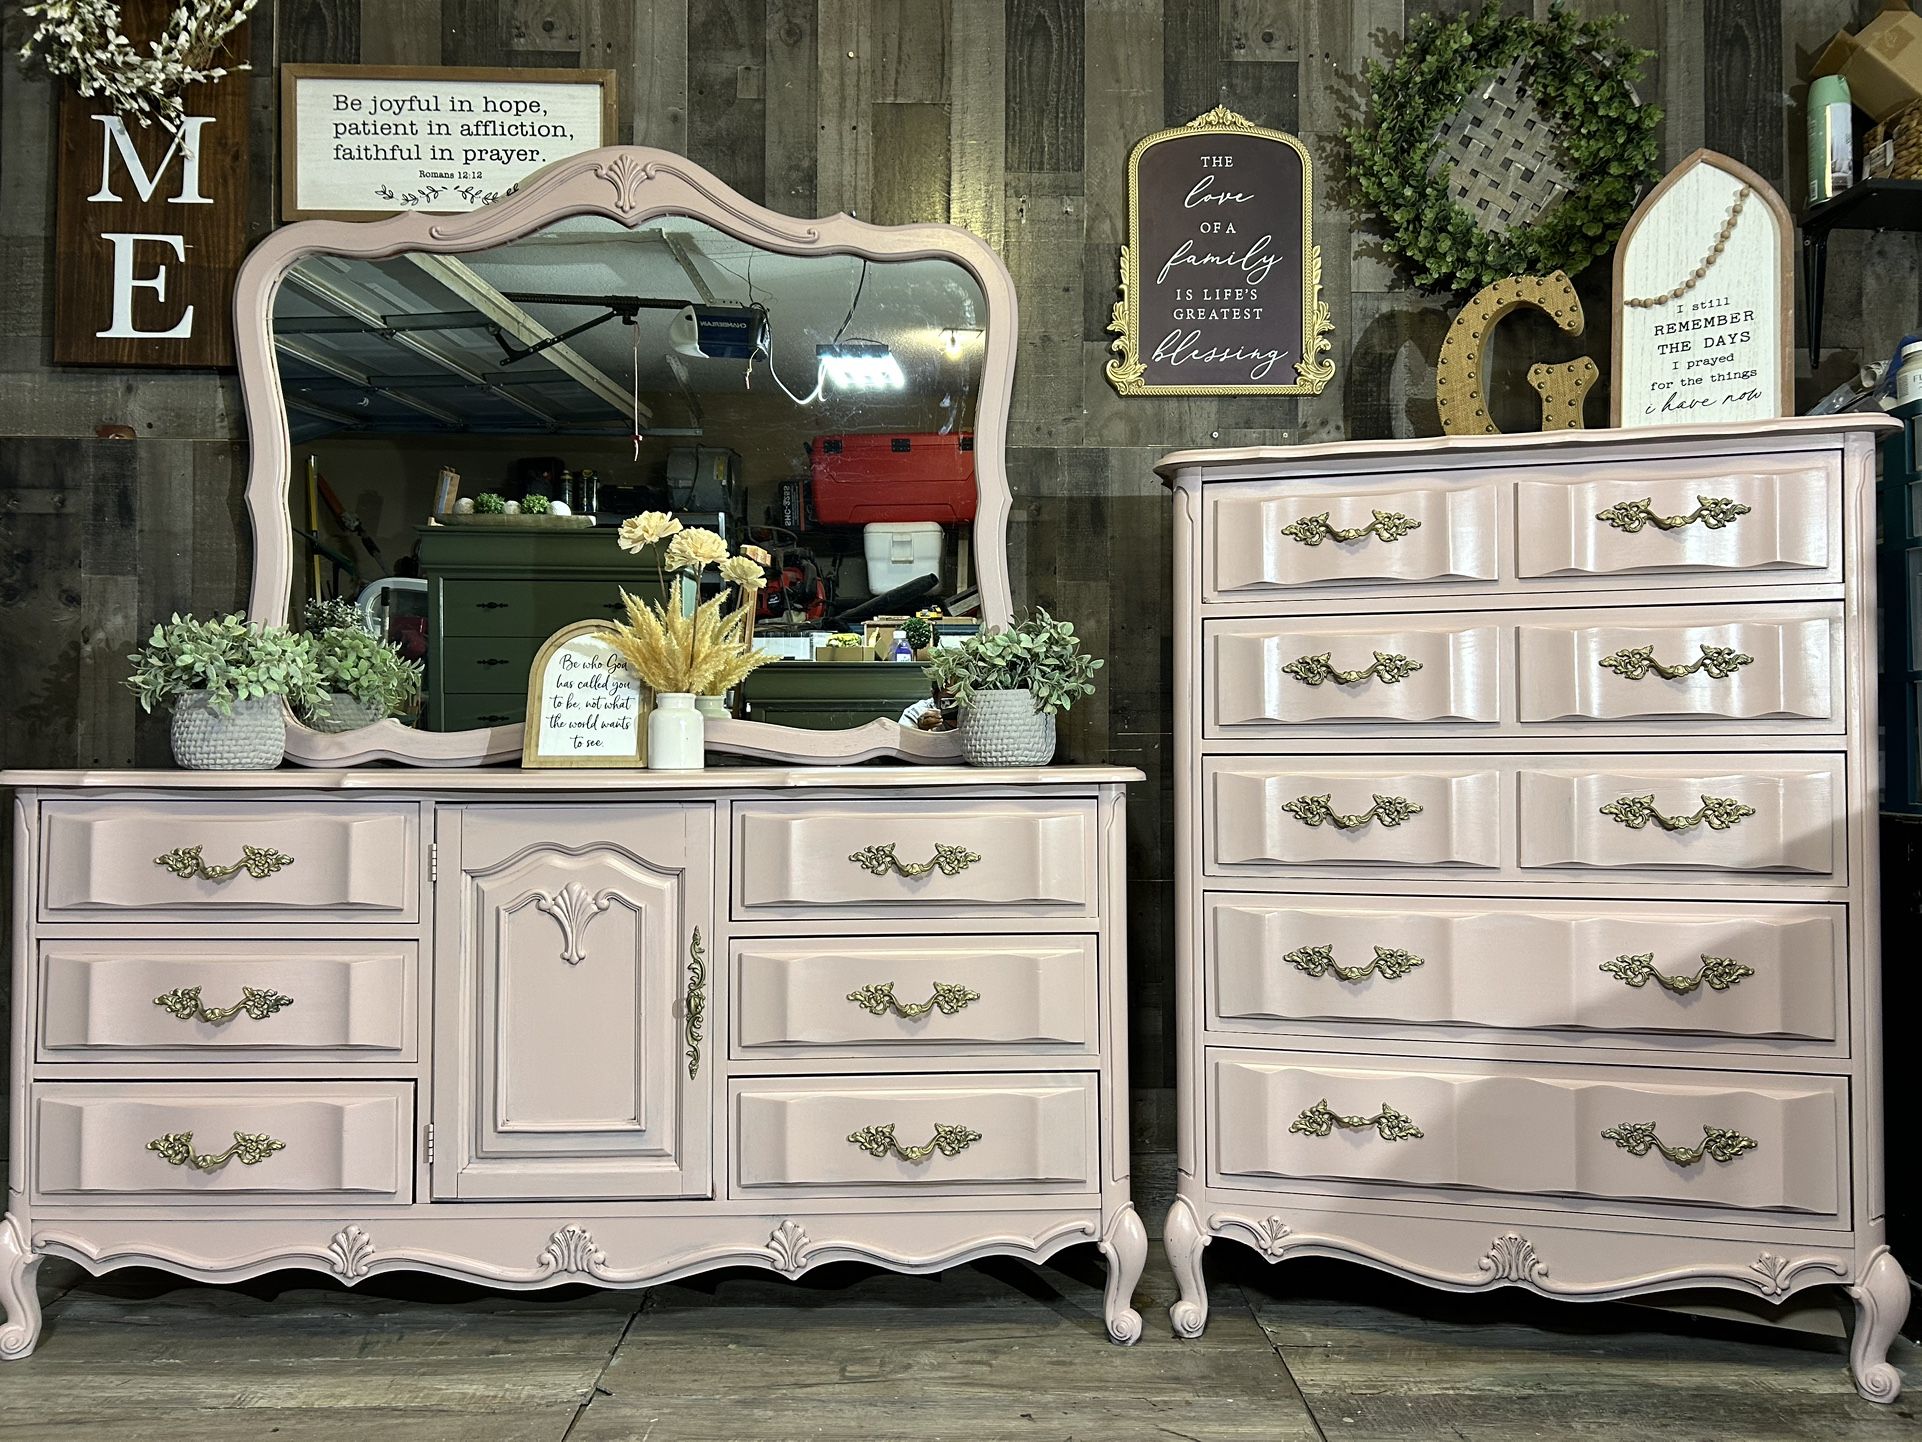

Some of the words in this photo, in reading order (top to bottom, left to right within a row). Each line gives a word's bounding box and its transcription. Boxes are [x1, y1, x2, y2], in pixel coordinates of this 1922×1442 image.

[332, 94, 362, 112] Be
[368, 95, 441, 116] joyful
[449, 96, 474, 113] in
[482, 96, 548, 117] hope,
[332, 119, 419, 139] patient
[427, 120, 451, 136] in
[459, 120, 574, 141] affliction,
[333, 143, 422, 161] faithful
[430, 145, 452, 161] in
[462, 148, 547, 165] prayer.
[1200, 155, 1234, 168] THE
[418, 169, 455, 179] Romans
[457, 171, 483, 180] 12:12
[1184, 174, 1255, 209] love
[1199, 221, 1221, 234] OF
[1225, 222, 1237, 234] A
[1156, 234, 1284, 286] family
[1176, 288, 1193, 301] IS
[1203, 288, 1258, 301] LIFE'S
[1173, 308, 1263, 321] GREATEST
[1677, 304, 1684, 314] I
[1692, 297, 1730, 311] still
[1654, 309, 1755, 337] REMEMBER
[1657, 340, 1692, 356] THE
[1704, 331, 1751, 349] DAYS
[1151, 328, 1289, 380] blessing
[1672, 361, 1679, 371] I
[1686, 353, 1735, 371] prayed
[1650, 381, 1674, 391] for
[1680, 377, 1703, 387] the
[1710, 369, 1758, 382] things
[1645, 403, 1656, 415] i
[1661, 391, 1717, 413] have
[1722, 388, 1762, 405] now
[559, 653, 580, 671] Be
[582, 654, 603, 670] who
[556, 674, 574, 689] has
[577, 673, 611, 691] called
[611, 681, 631, 696] you
[549, 695, 563, 709] to
[566, 693, 581, 710] be,
[585, 696, 607, 710] not
[604, 694, 635, 711] what
[546, 713, 567, 729] the
[568, 713, 599, 731] world
[600, 716, 631, 730] wants
[570, 735, 584, 749] to
[586, 739, 605, 748] see.
